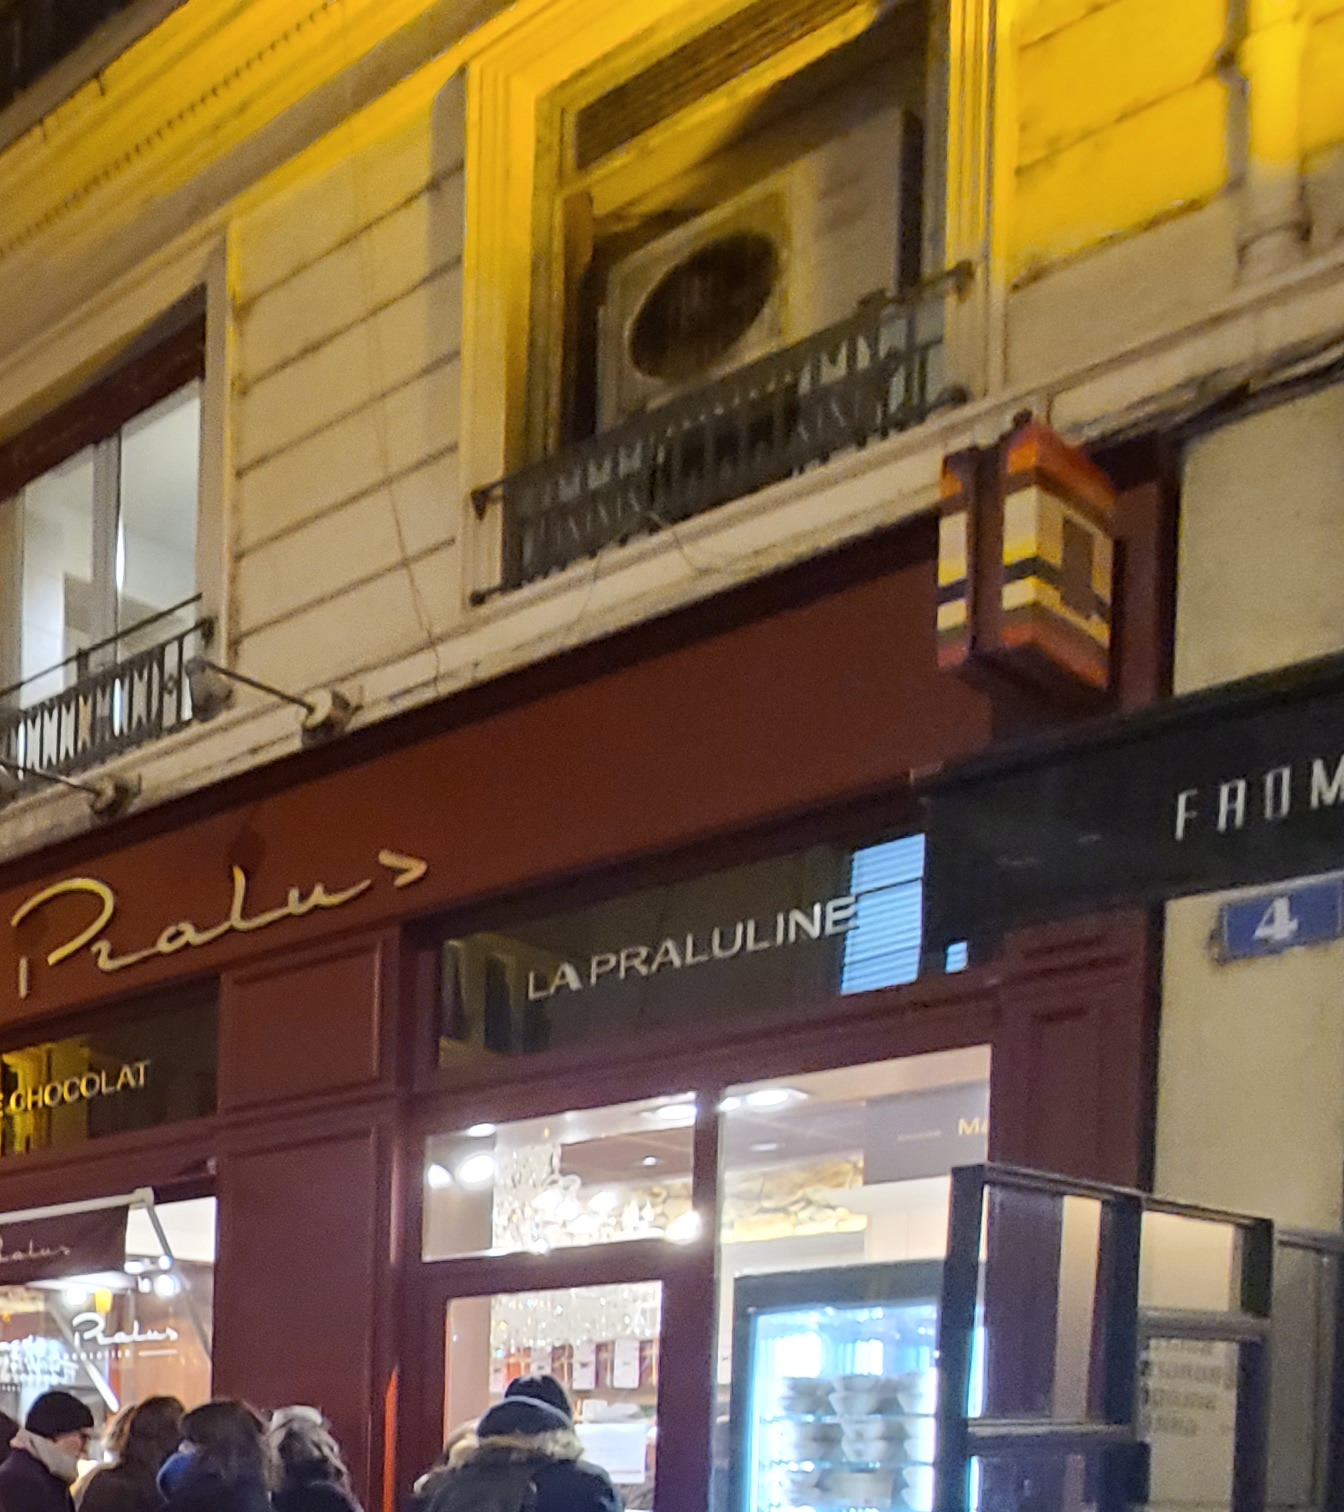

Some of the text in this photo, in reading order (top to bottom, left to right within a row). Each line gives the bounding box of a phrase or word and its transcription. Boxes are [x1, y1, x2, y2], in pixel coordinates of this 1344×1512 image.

[11, 850, 428, 999] Pralus
[1252, 896, 1299, 941] 4
[527, 894, 858, 1001] LA PRALULINE
[9, 1060, 151, 1114] CHOCOLAT
[72, 1312, 179, 1347] Pralus
